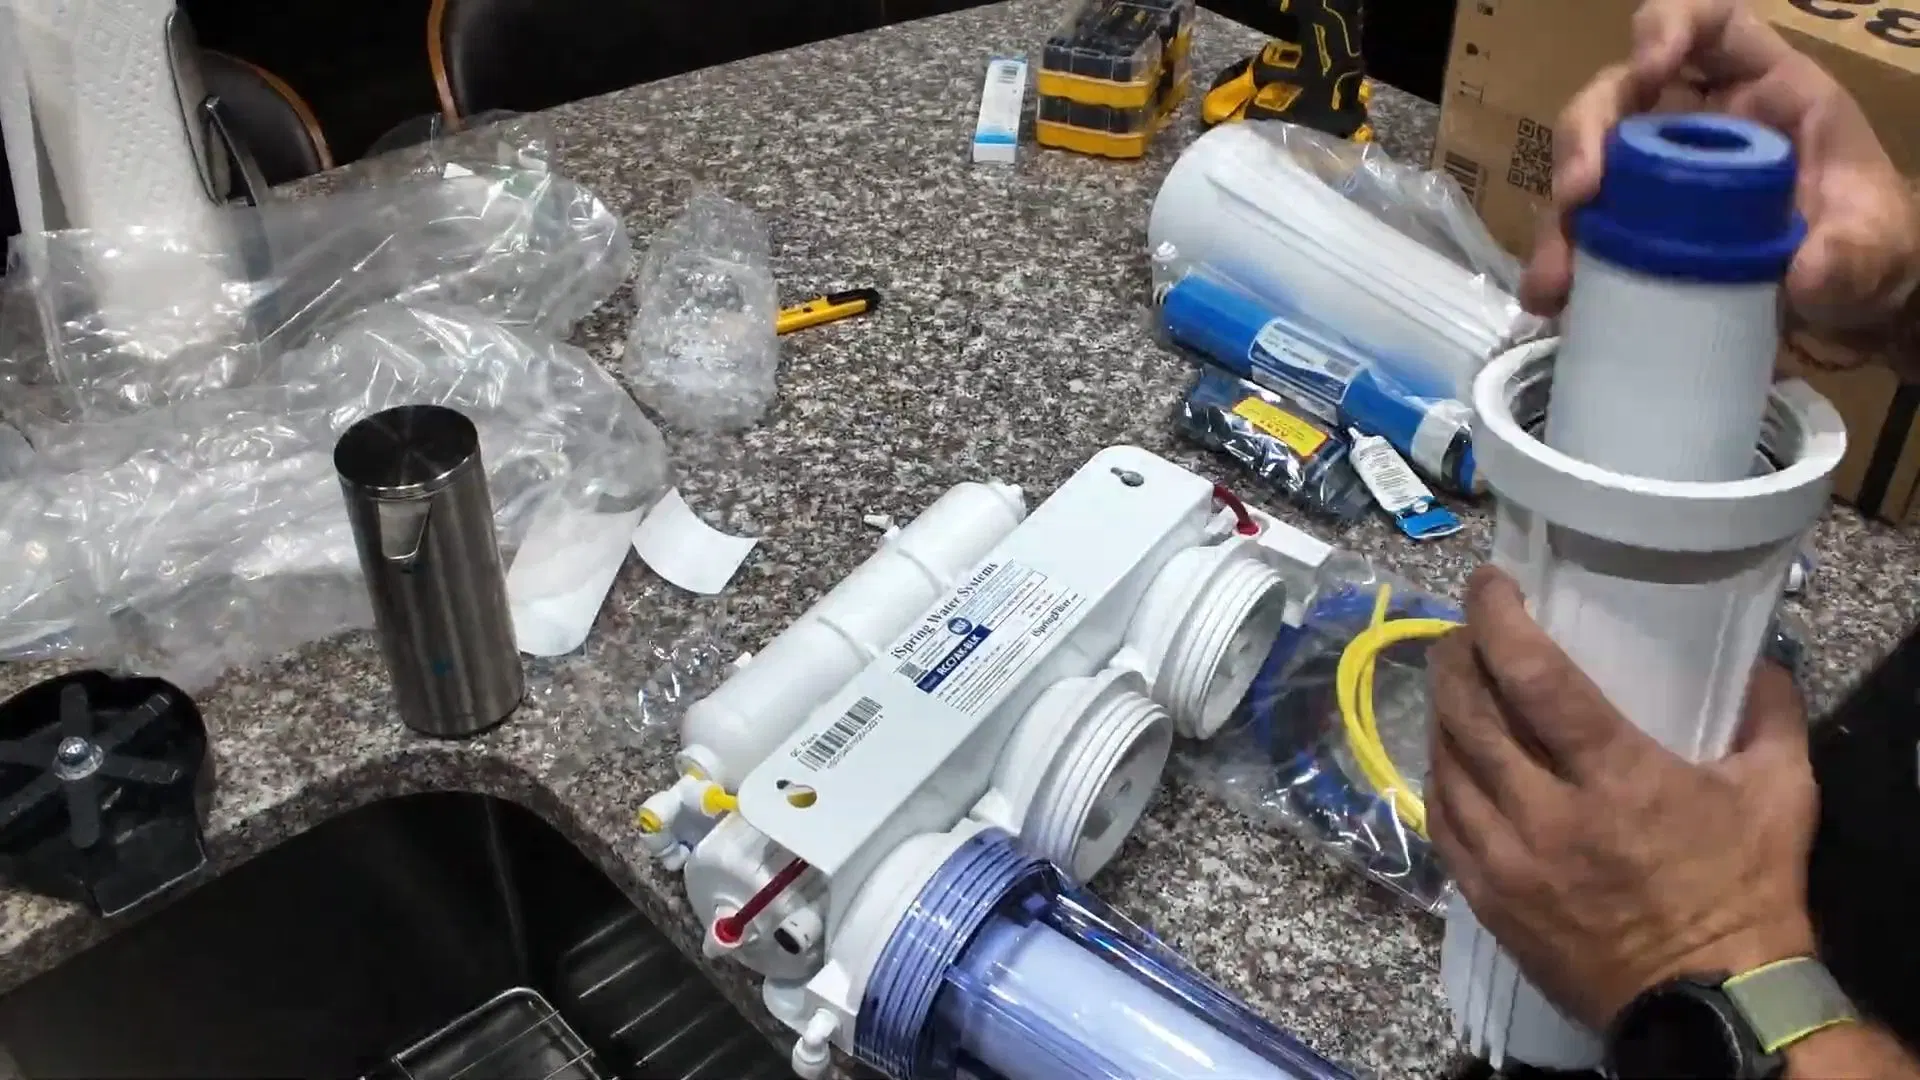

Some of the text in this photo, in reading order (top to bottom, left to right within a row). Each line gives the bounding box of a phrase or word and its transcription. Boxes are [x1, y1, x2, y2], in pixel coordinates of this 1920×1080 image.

[890, 624, 936, 659] iSpring
[926, 597, 961, 623] Water
[956, 562, 999, 597] Systems
